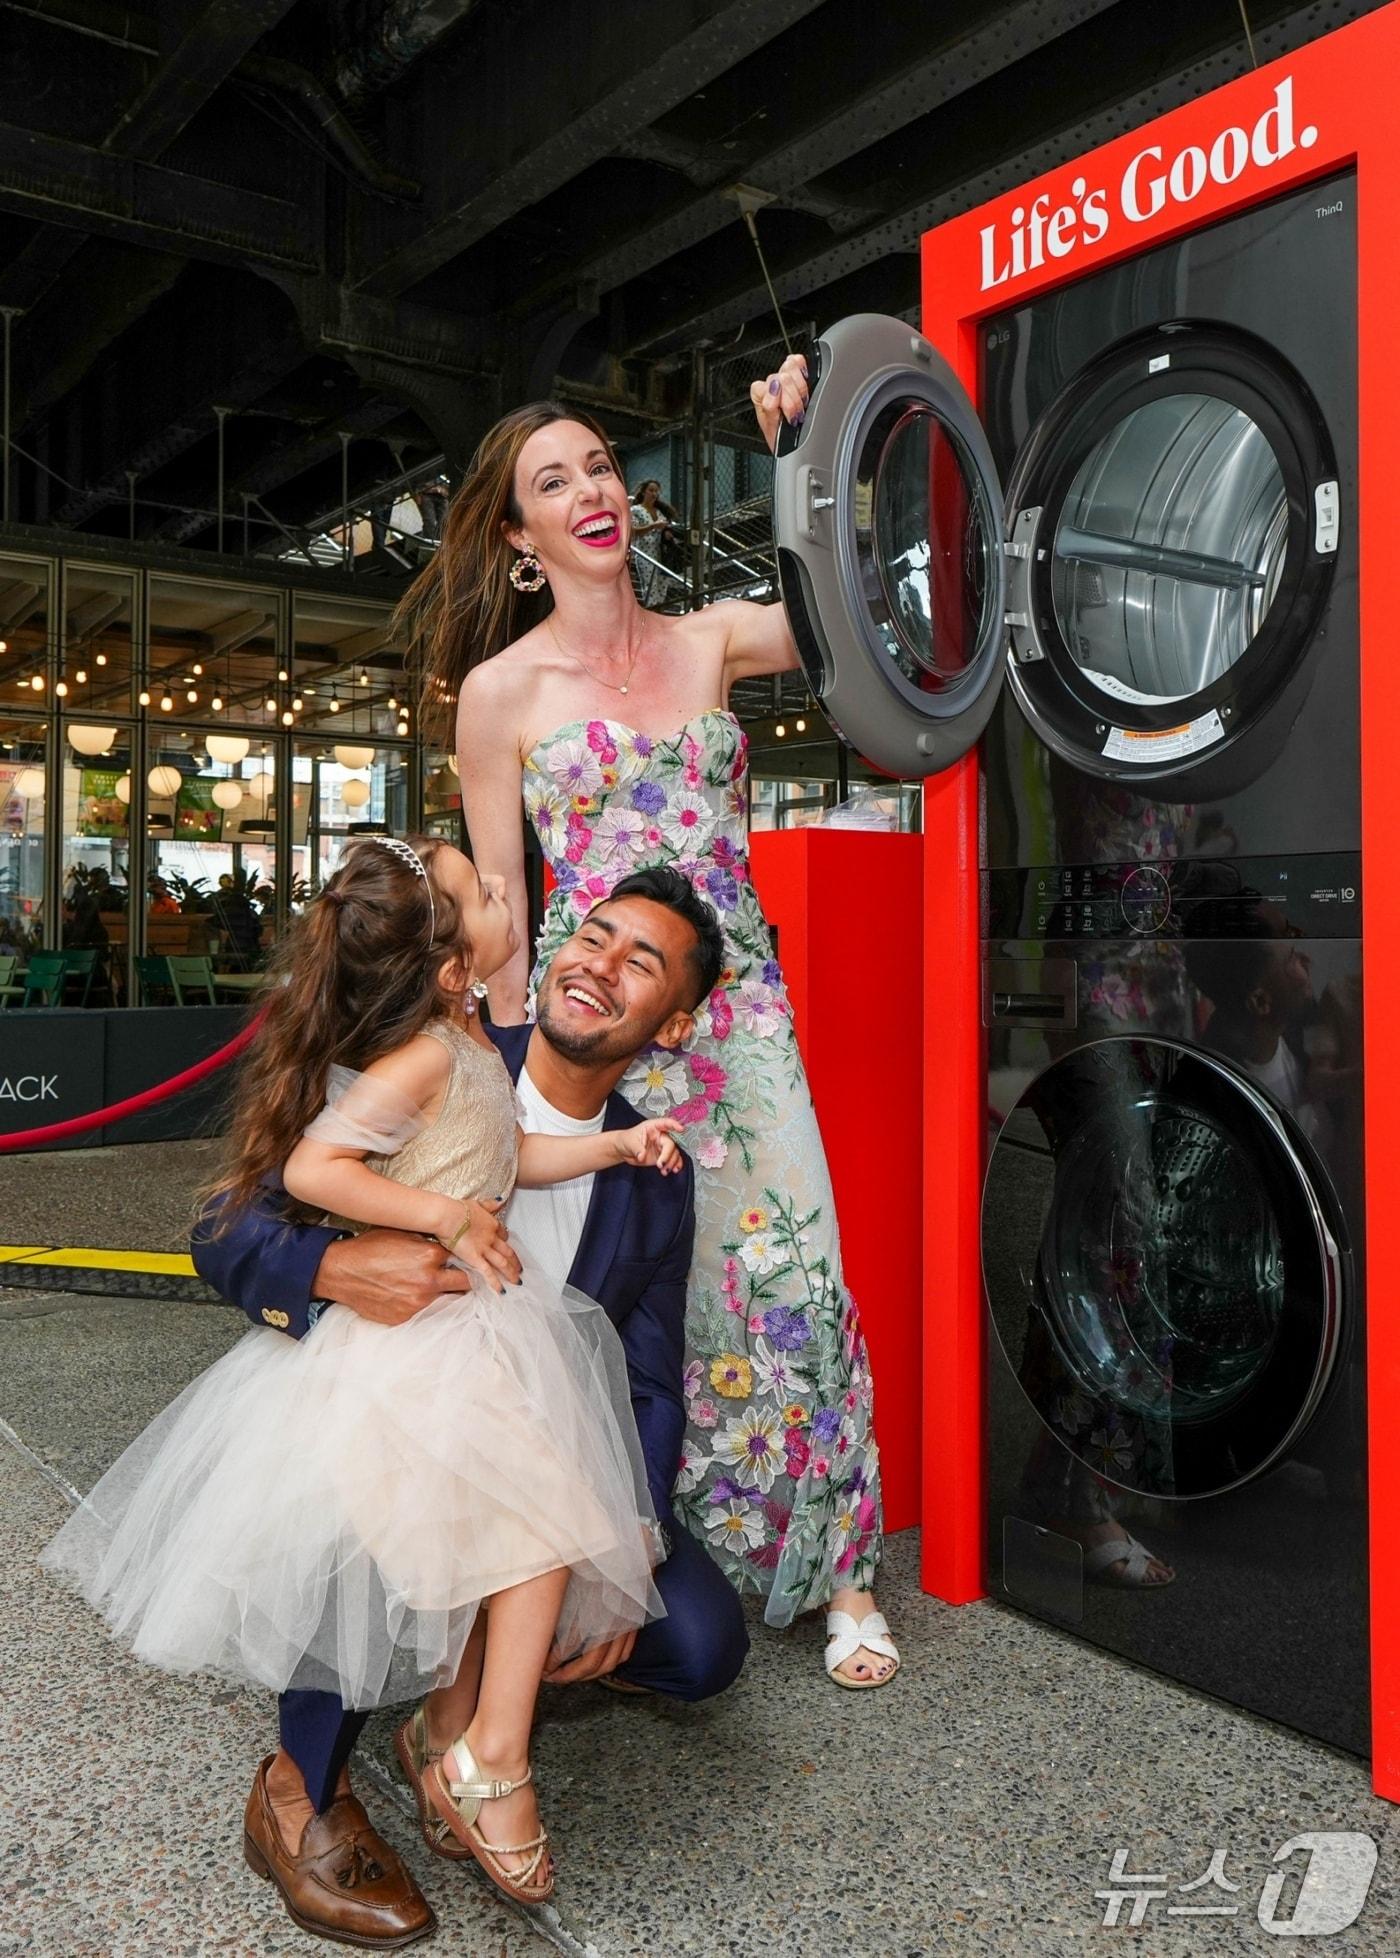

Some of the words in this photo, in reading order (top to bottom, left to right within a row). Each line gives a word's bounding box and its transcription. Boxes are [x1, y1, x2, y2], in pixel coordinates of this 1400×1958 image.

[1120, 75, 1319, 223] Good.
[1314, 200, 1343, 219] ThinQ
[998, 330, 1010, 345] LG
